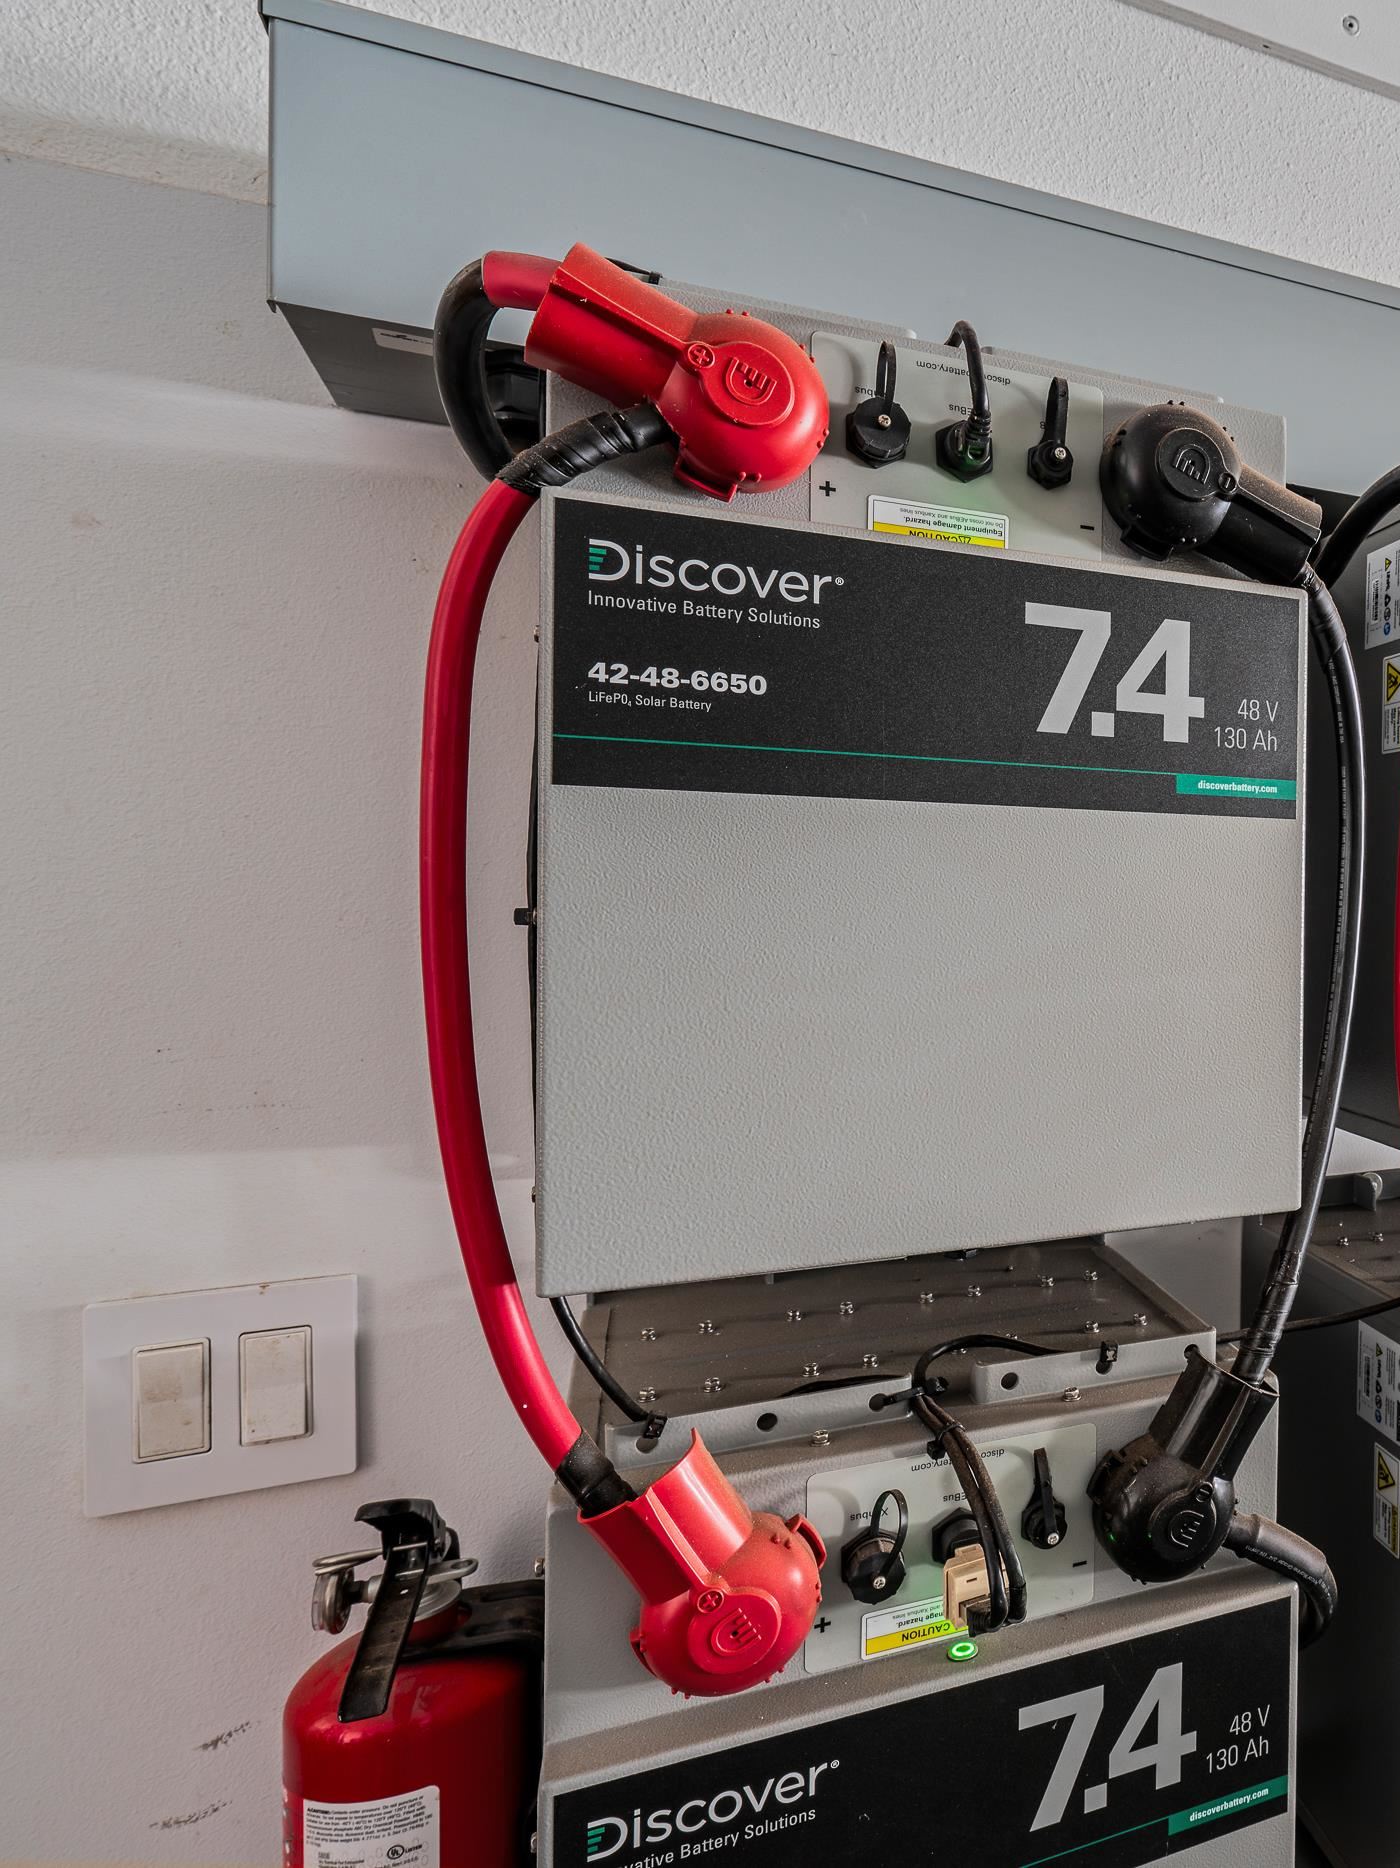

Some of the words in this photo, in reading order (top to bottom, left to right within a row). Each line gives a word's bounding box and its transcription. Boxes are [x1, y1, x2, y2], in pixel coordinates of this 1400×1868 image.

[904, 516, 931, 526] hazard.
[932, 520, 962, 531] damage
[964, 525, 1003, 537] Equipment
[588, 590, 677, 614] Innovative
[683, 601, 743, 623] Battery
[748, 608, 820, 629] Solutions
[587, 662, 767, 696] 42-48-6650
[1025, 602, 1204, 743] 7.4
[635, 695, 665, 707] Solar
[670, 698, 712, 712] Battery
[1238, 699, 1260, 721] 48
[1266, 700, 1278, 722] V
[1214, 727, 1246, 749] 130
[1253, 729, 1277, 751] Ah
[1198, 780, 1277, 794] discoverbattery.com
[943, 1492, 967, 1502] EBus
[898, 1617, 924, 1628] hazard.
[901, 1622, 950, 1642] CAUTION
[1229, 1711, 1252, 1735] 48
[1258, 1704, 1270, 1727] V
[1018, 1661, 1197, 1832] 7.4
[1206, 1745, 1238, 1774] 130
[1244, 1735, 1269, 1762] Ah
[1189, 1787, 1269, 1822] discoverbattery.com
[680, 1831, 740, 1859] Battery
[744, 1809, 816, 1839] Solutions
